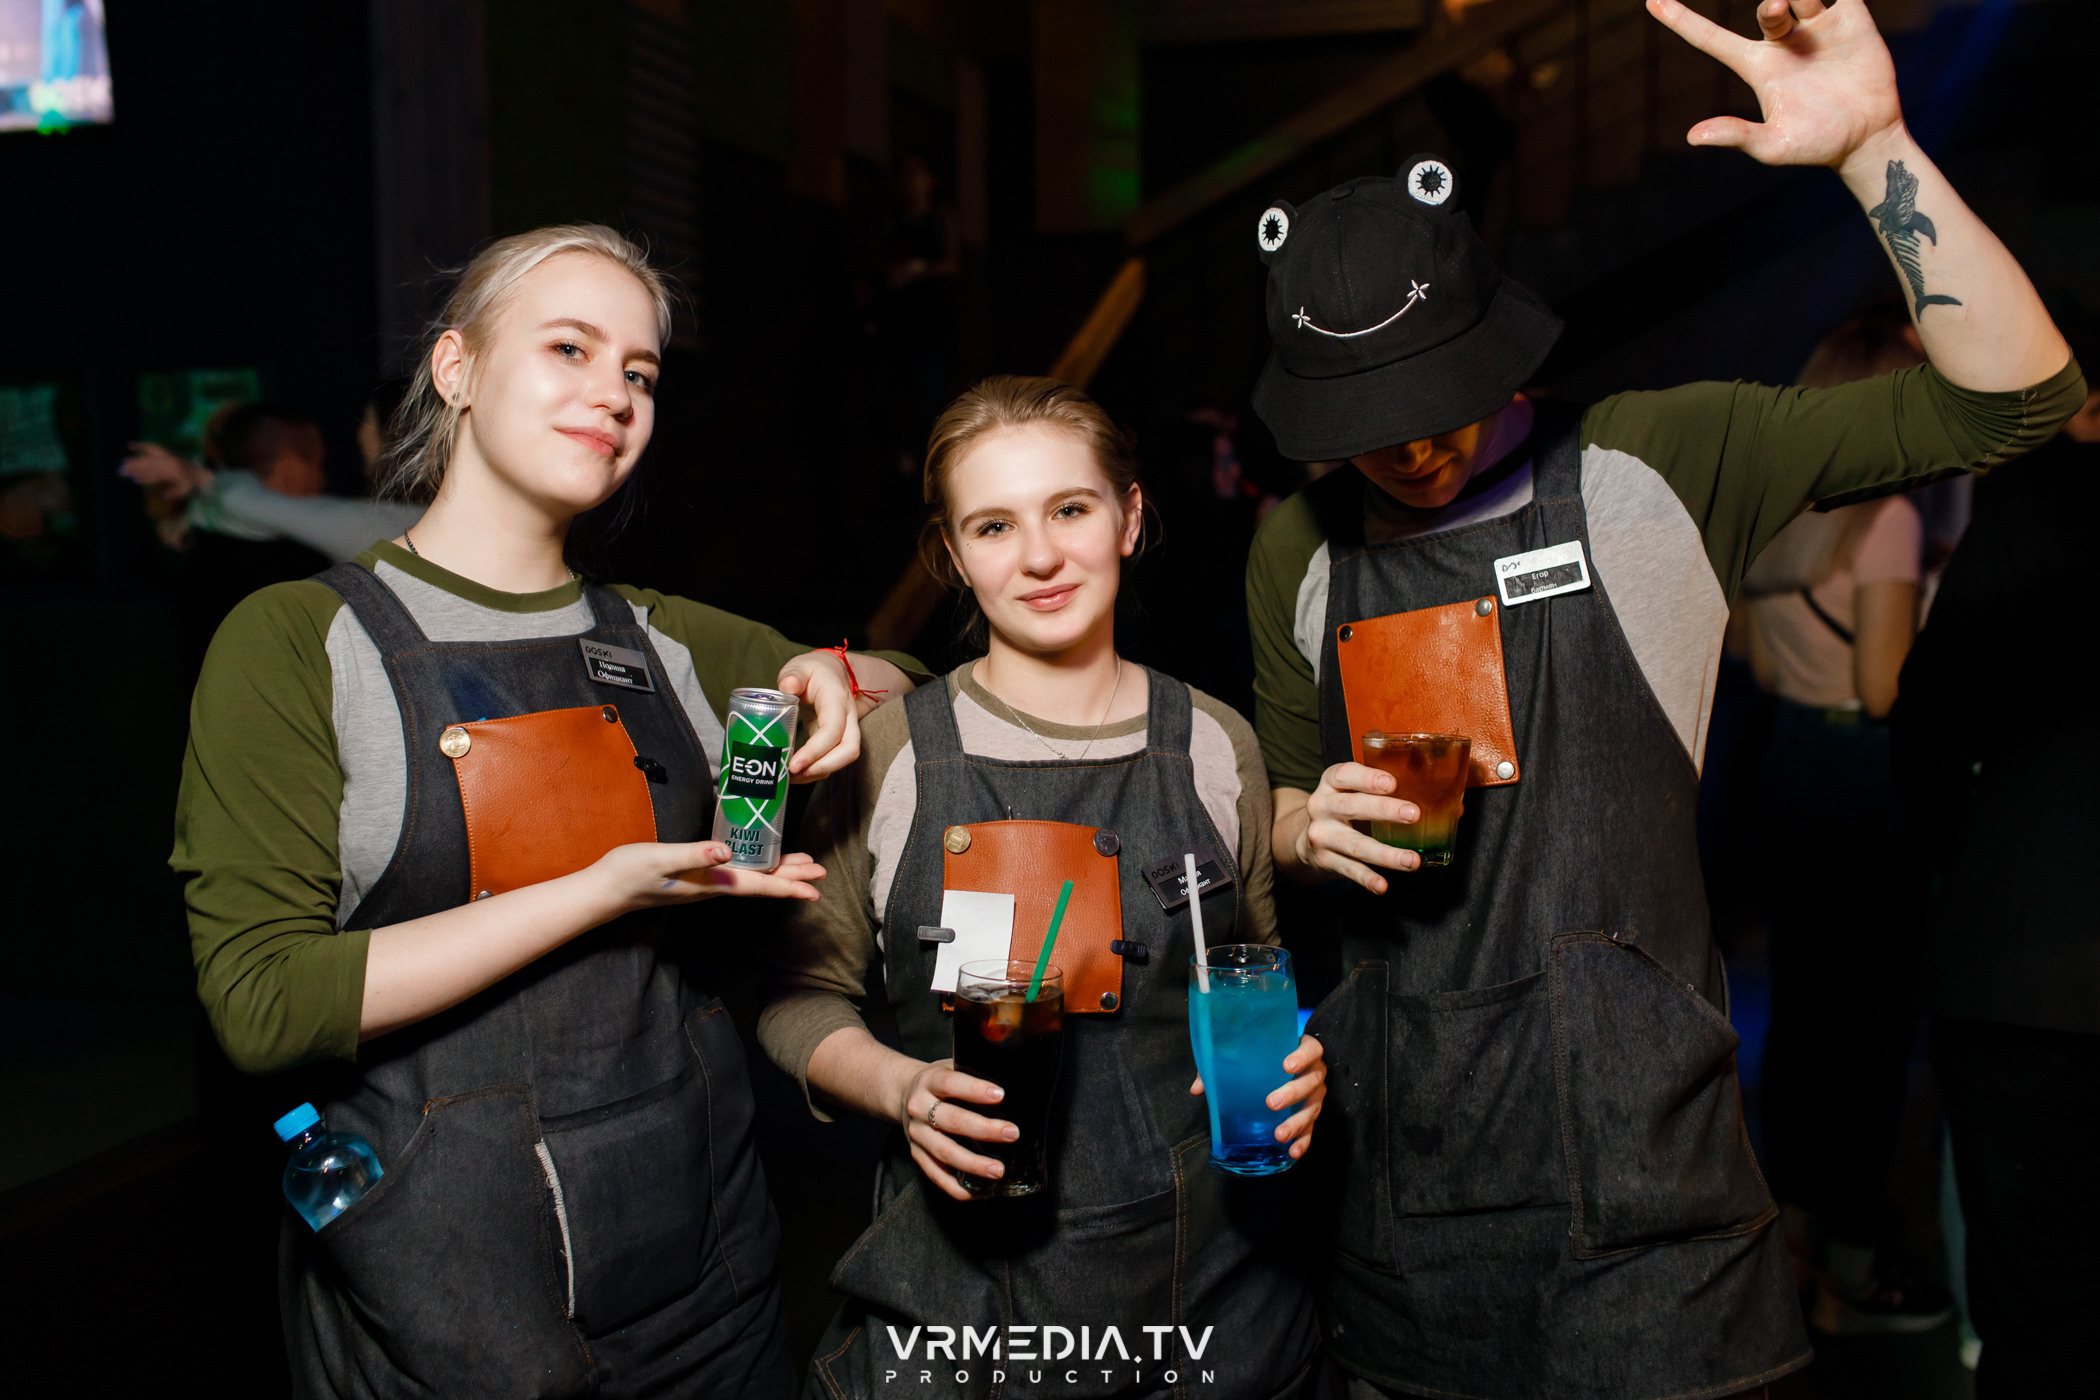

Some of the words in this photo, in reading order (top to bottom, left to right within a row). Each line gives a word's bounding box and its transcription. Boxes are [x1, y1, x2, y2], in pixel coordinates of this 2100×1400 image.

[1531, 570, 1549, 580] Егор
[731, 774, 754, 784] ENERGY
[730, 827, 760, 842] KIWI
[1151, 861, 1180, 879] DOSKI
